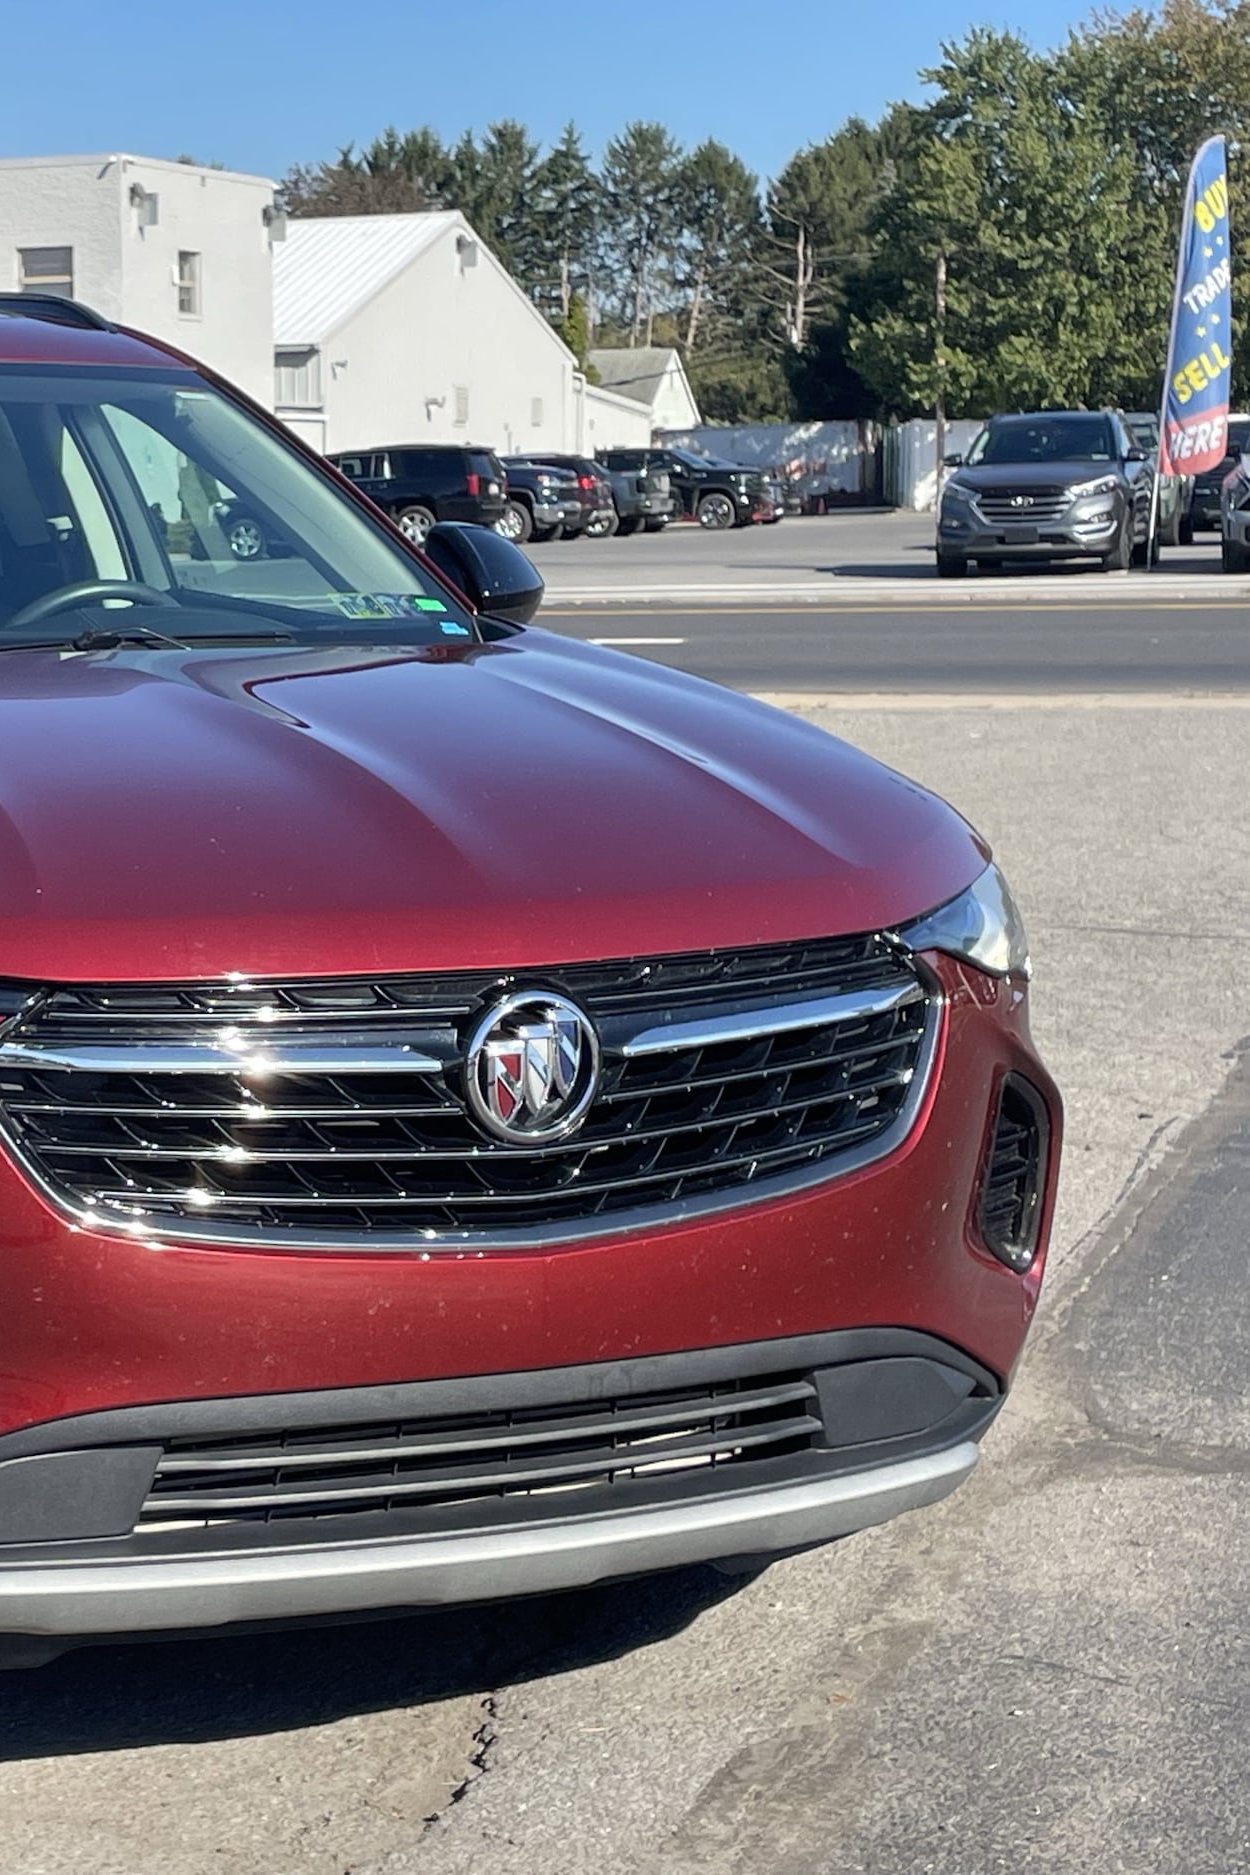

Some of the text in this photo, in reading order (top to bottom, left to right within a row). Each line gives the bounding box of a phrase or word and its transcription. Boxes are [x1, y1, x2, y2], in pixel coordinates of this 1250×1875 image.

[1194, 172, 1228, 234] BUY
[1182, 257, 1230, 315] TRADE
[1172, 341, 1230, 405] SELL
[1170, 415, 1224, 460] HERE
